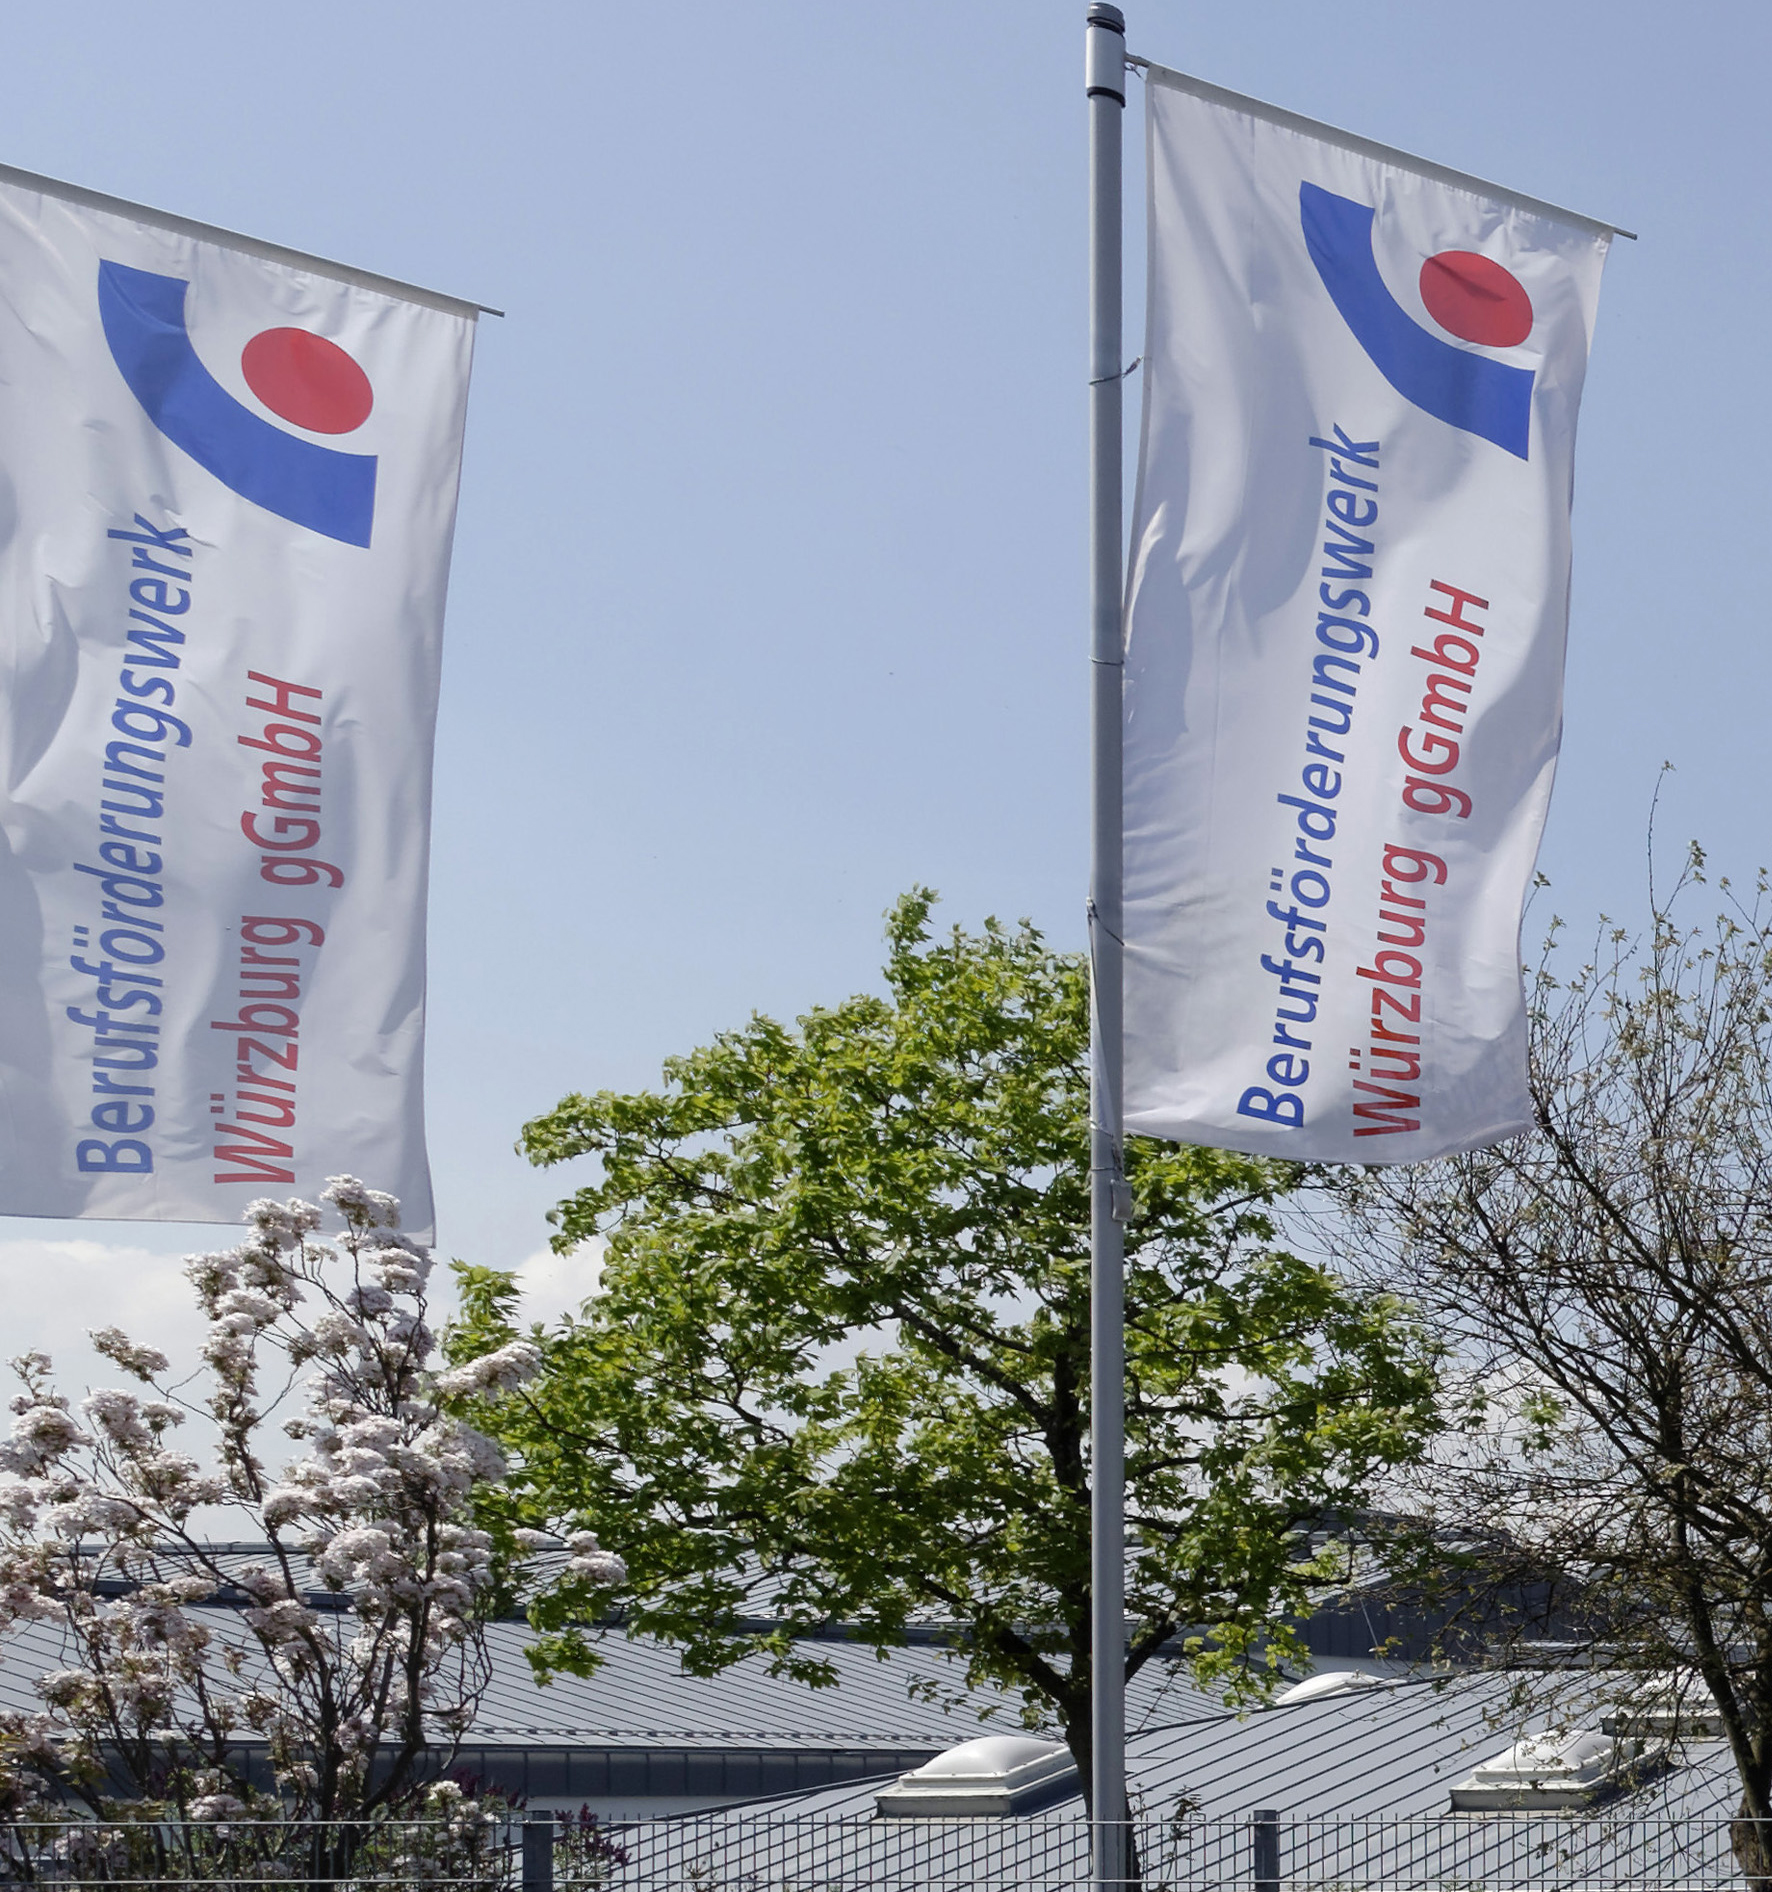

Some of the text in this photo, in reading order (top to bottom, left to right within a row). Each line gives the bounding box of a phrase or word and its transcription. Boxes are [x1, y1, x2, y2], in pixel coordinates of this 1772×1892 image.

[68, 511, 196, 1176] Berufsförderungswerk
[213, 669, 345, 1185] Würzburg gGmbH
[1235, 422, 1383, 1130] Berufsförderungswerk
[1350, 579, 1489, 1138] Würzburg gGmbH
